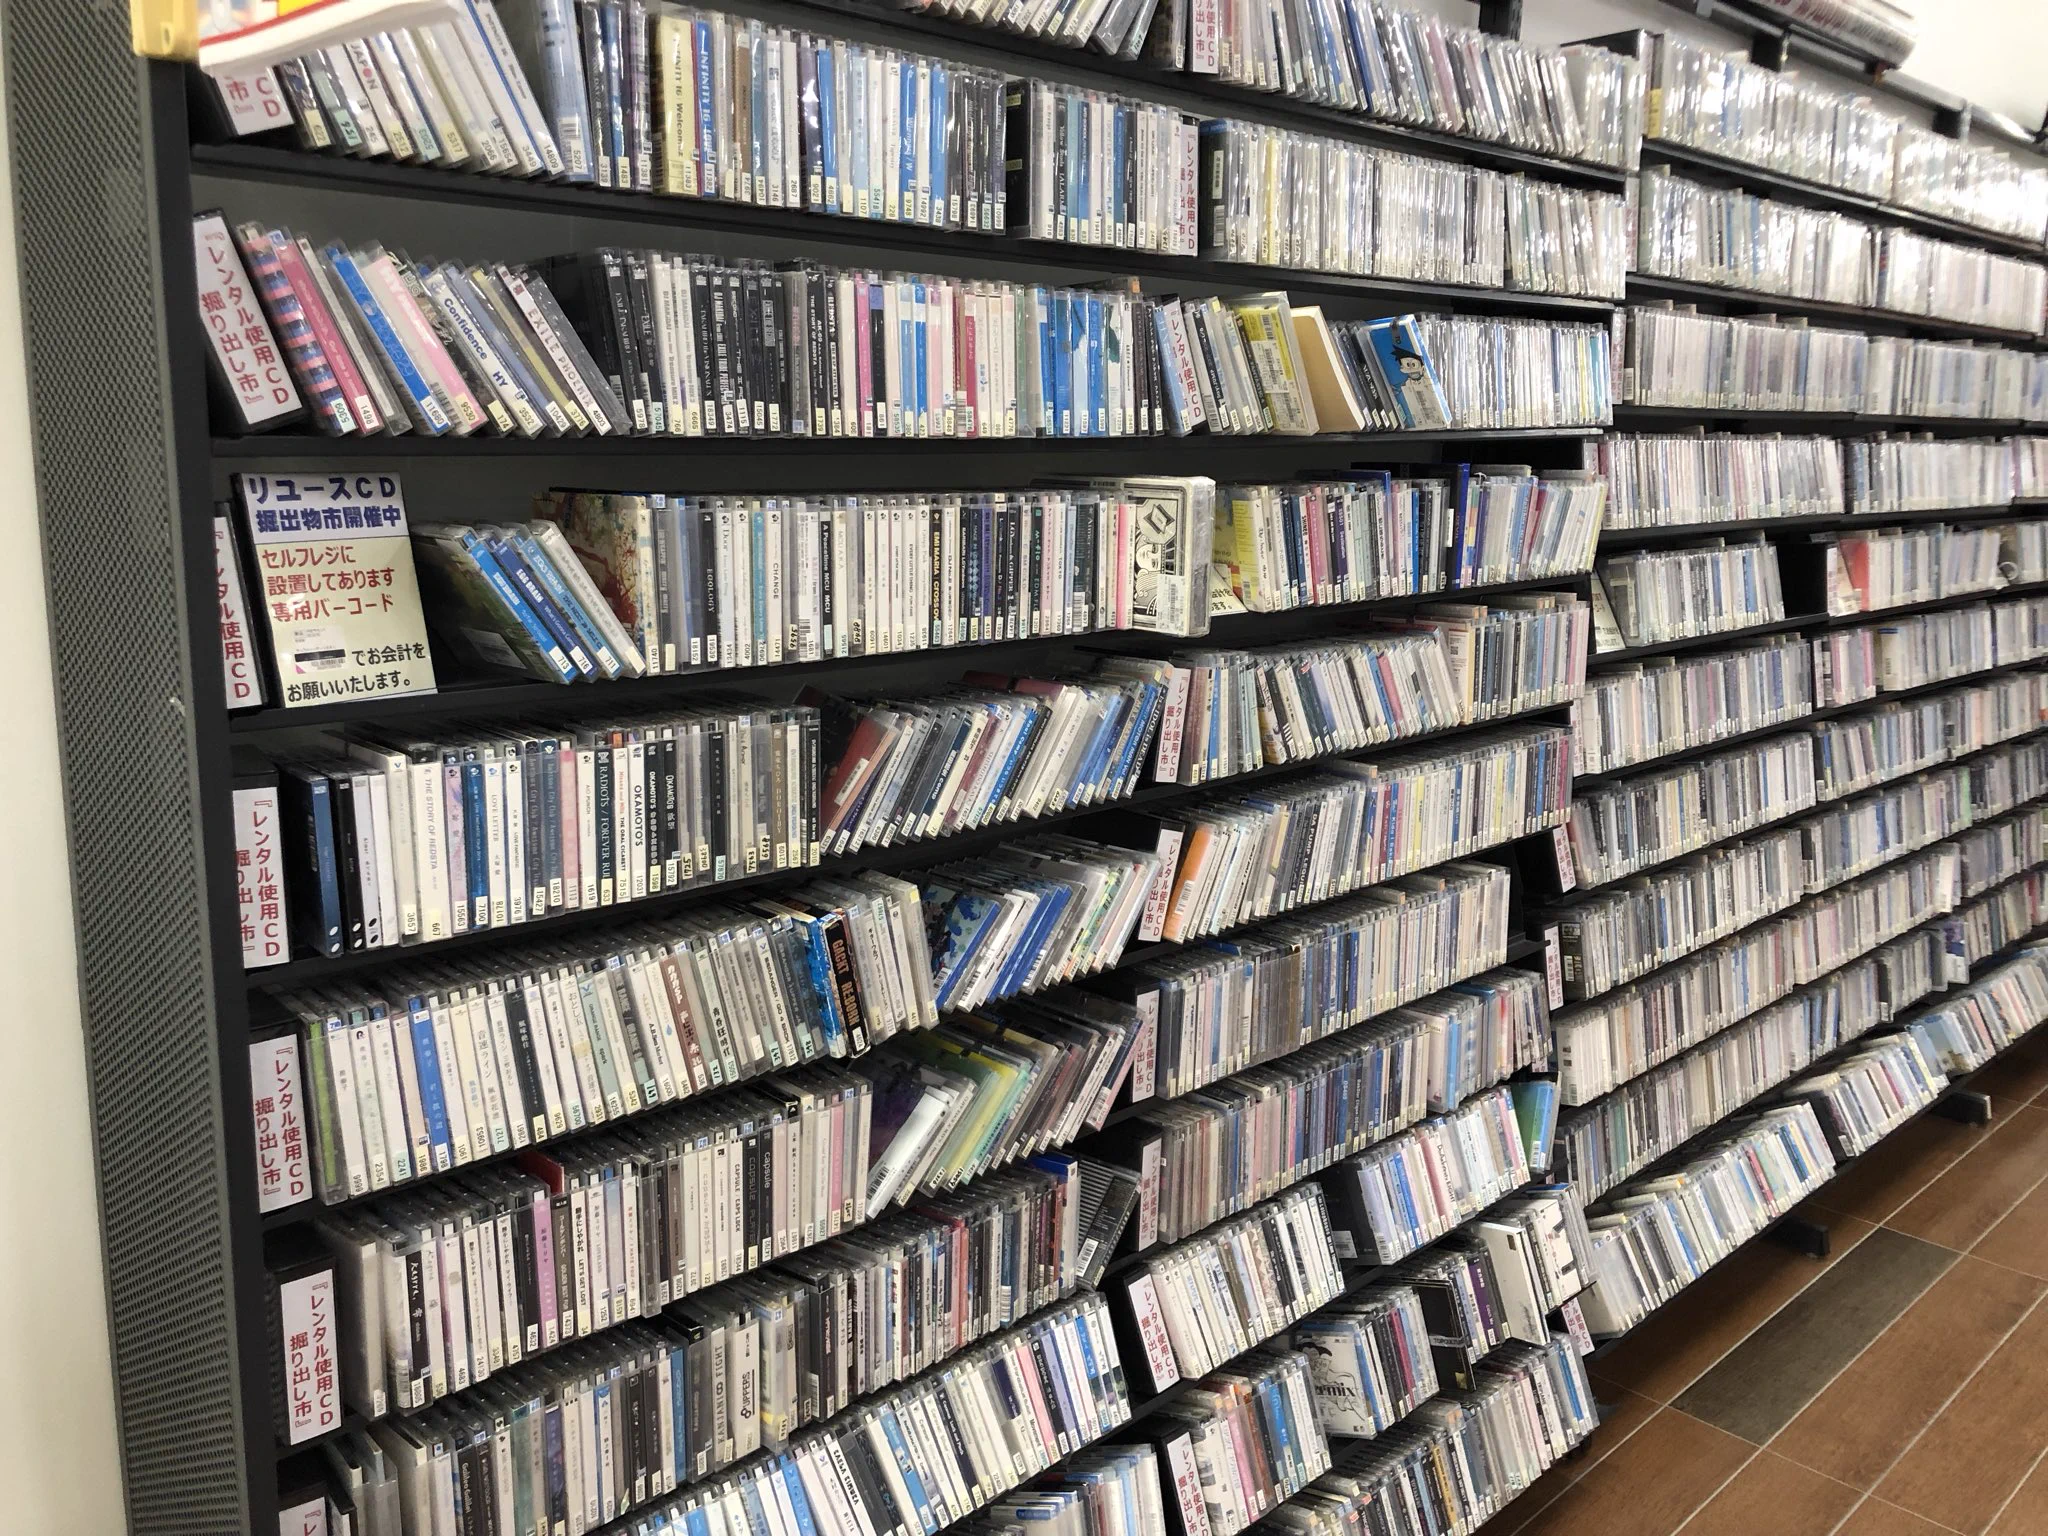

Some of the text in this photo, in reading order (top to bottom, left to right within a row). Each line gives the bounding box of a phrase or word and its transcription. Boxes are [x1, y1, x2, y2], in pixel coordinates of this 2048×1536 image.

[447, 132, 463, 153] 5317
[481, 140, 498, 162] 2066
[501, 138, 513, 164] 15654
[522, 145, 537, 167] 3449
[543, 144, 557, 169] 14809
[574, 150, 582, 170] 5207
[641, 158, 649, 184] 11381
[706, 167, 714, 193] 11382
[790, 179, 798, 198] 2687
[528, 308, 560, 353] EXILE
[202, 292, 265, 405] 掘り出し市』
[444, 298, 509, 388] Confidence HY
[360, 405, 374, 425] 1498
[426, 402, 445, 425] 11680
[461, 402, 477, 421] 9530
[497, 415, 508, 429] 174
[519, 407, 535, 426] 3532
[550, 405, 567, 429] 10429
[569, 408, 585, 427] 3776
[593, 409, 607, 427] 4803
[636, 407, 646, 428] 5978
[725, 410, 733, 430] 3474
[740, 404, 748, 425] 1115
[249, 476, 397, 505] リユースCD
[255, 504, 402, 533] 掘出物市開催中
[262, 545, 356, 569] セルフレジに
[267, 567, 395, 597] 設置してあります
[516, 568, 544, 603] EGG BRAIN
[706, 568, 714, 613] EGOLOGY
[272, 592, 394, 623] 専用バーコード
[352, 642, 426, 667] でお会計を
[557, 654, 570, 670] 713
[578, 656, 588, 670] 716
[604, 656, 617, 669] 711
[287, 670, 411, 703] お願いいたします。
[649, 770, 657, 809] OKAMOTO'S
[427, 800, 435, 823] STORY
[633, 784, 644, 847] OKAMOTO'S
[600, 817, 610, 859] FOREVER
[1308, 826, 1318, 858] PUMP
[252, 799, 281, 957] 『レンタル使用CD
[634, 875, 643, 896] 12031
[535, 890, 544, 913] 15427
[588, 883, 596, 901] 1619
[602, 888, 610, 904] 633
[406, 913, 417, 933] 3657
[456, 904, 465, 928] 15563
[478, 905, 486, 923] 7100
[432, 922, 441, 937] 667
[832, 939, 860, 1028] GACKT RE:BORN
[276, 1046, 304, 1196] 『レンタル使用CD
[255, 1097, 282, 1196] 掘り出し市』
[397, 1158, 406, 1176] 2241
[439, 1151, 448, 1170] 1798
[375, 1162, 384, 1184] 2354
[529, 1330, 537, 1348] 4632
[311, 1282, 333, 1426] 『レンタル使用CD
[714, 1345, 724, 1377] FIGHT
[290, 1331, 312, 1428] 掘り出し市』
[458, 1367, 467, 1386] 4683
